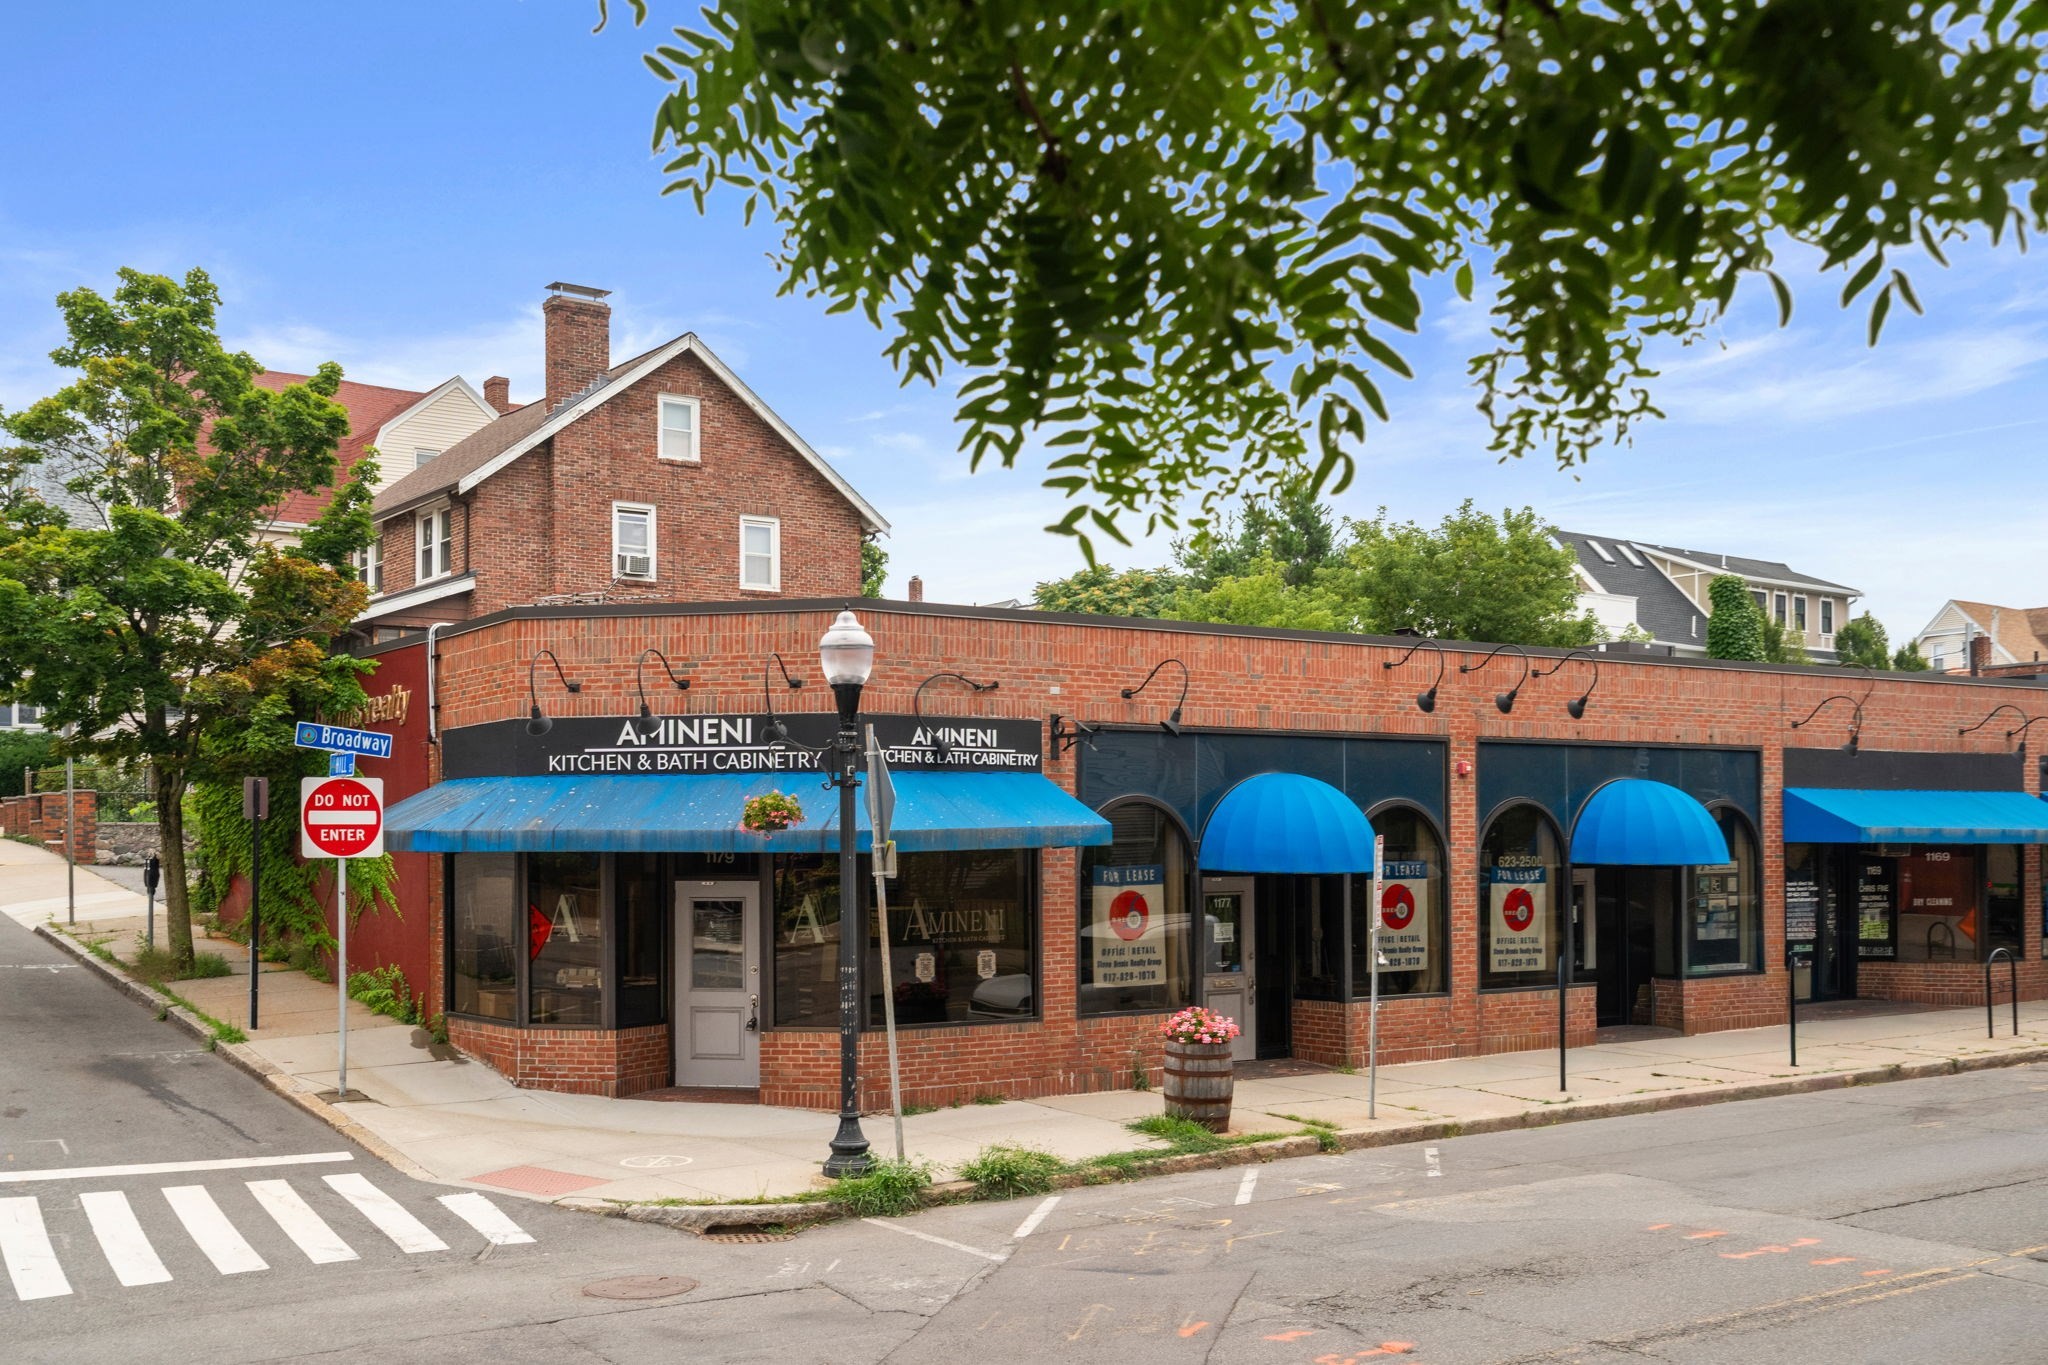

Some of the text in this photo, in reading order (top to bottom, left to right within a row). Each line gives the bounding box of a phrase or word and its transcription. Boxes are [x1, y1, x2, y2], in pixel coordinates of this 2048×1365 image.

[364, 684, 412, 726] realty
[616, 718, 752, 746] AMINENI
[911, 727, 997, 748] AMINENI
[321, 726, 389, 757] Broadway
[549, 751, 823, 772] KITCHEN & BATH CABINETRY
[881, 750, 922, 763] TCHEN
[924, 752, 935, 764] &
[972, 752, 1038, 767] CABINETRY
[314, 794, 370, 807] DO NOT
[320, 829, 365, 841] ENTER
[1498, 855, 1543, 867] 623-2500
[1925, 852, 1951, 861] 1169
[1103, 869, 1155, 882] FOR LEASE
[1395, 864, 1421, 876] LEASE
[1497, 869, 1540, 880] FOR LEASE
[1214, 897, 1232, 908] 1177
[903, 898, 1005, 941] AMINENI
[1377, 935, 1421, 944] FFICE RETAIL
[1101, 946, 1157, 957] OFFICE RETAIL
